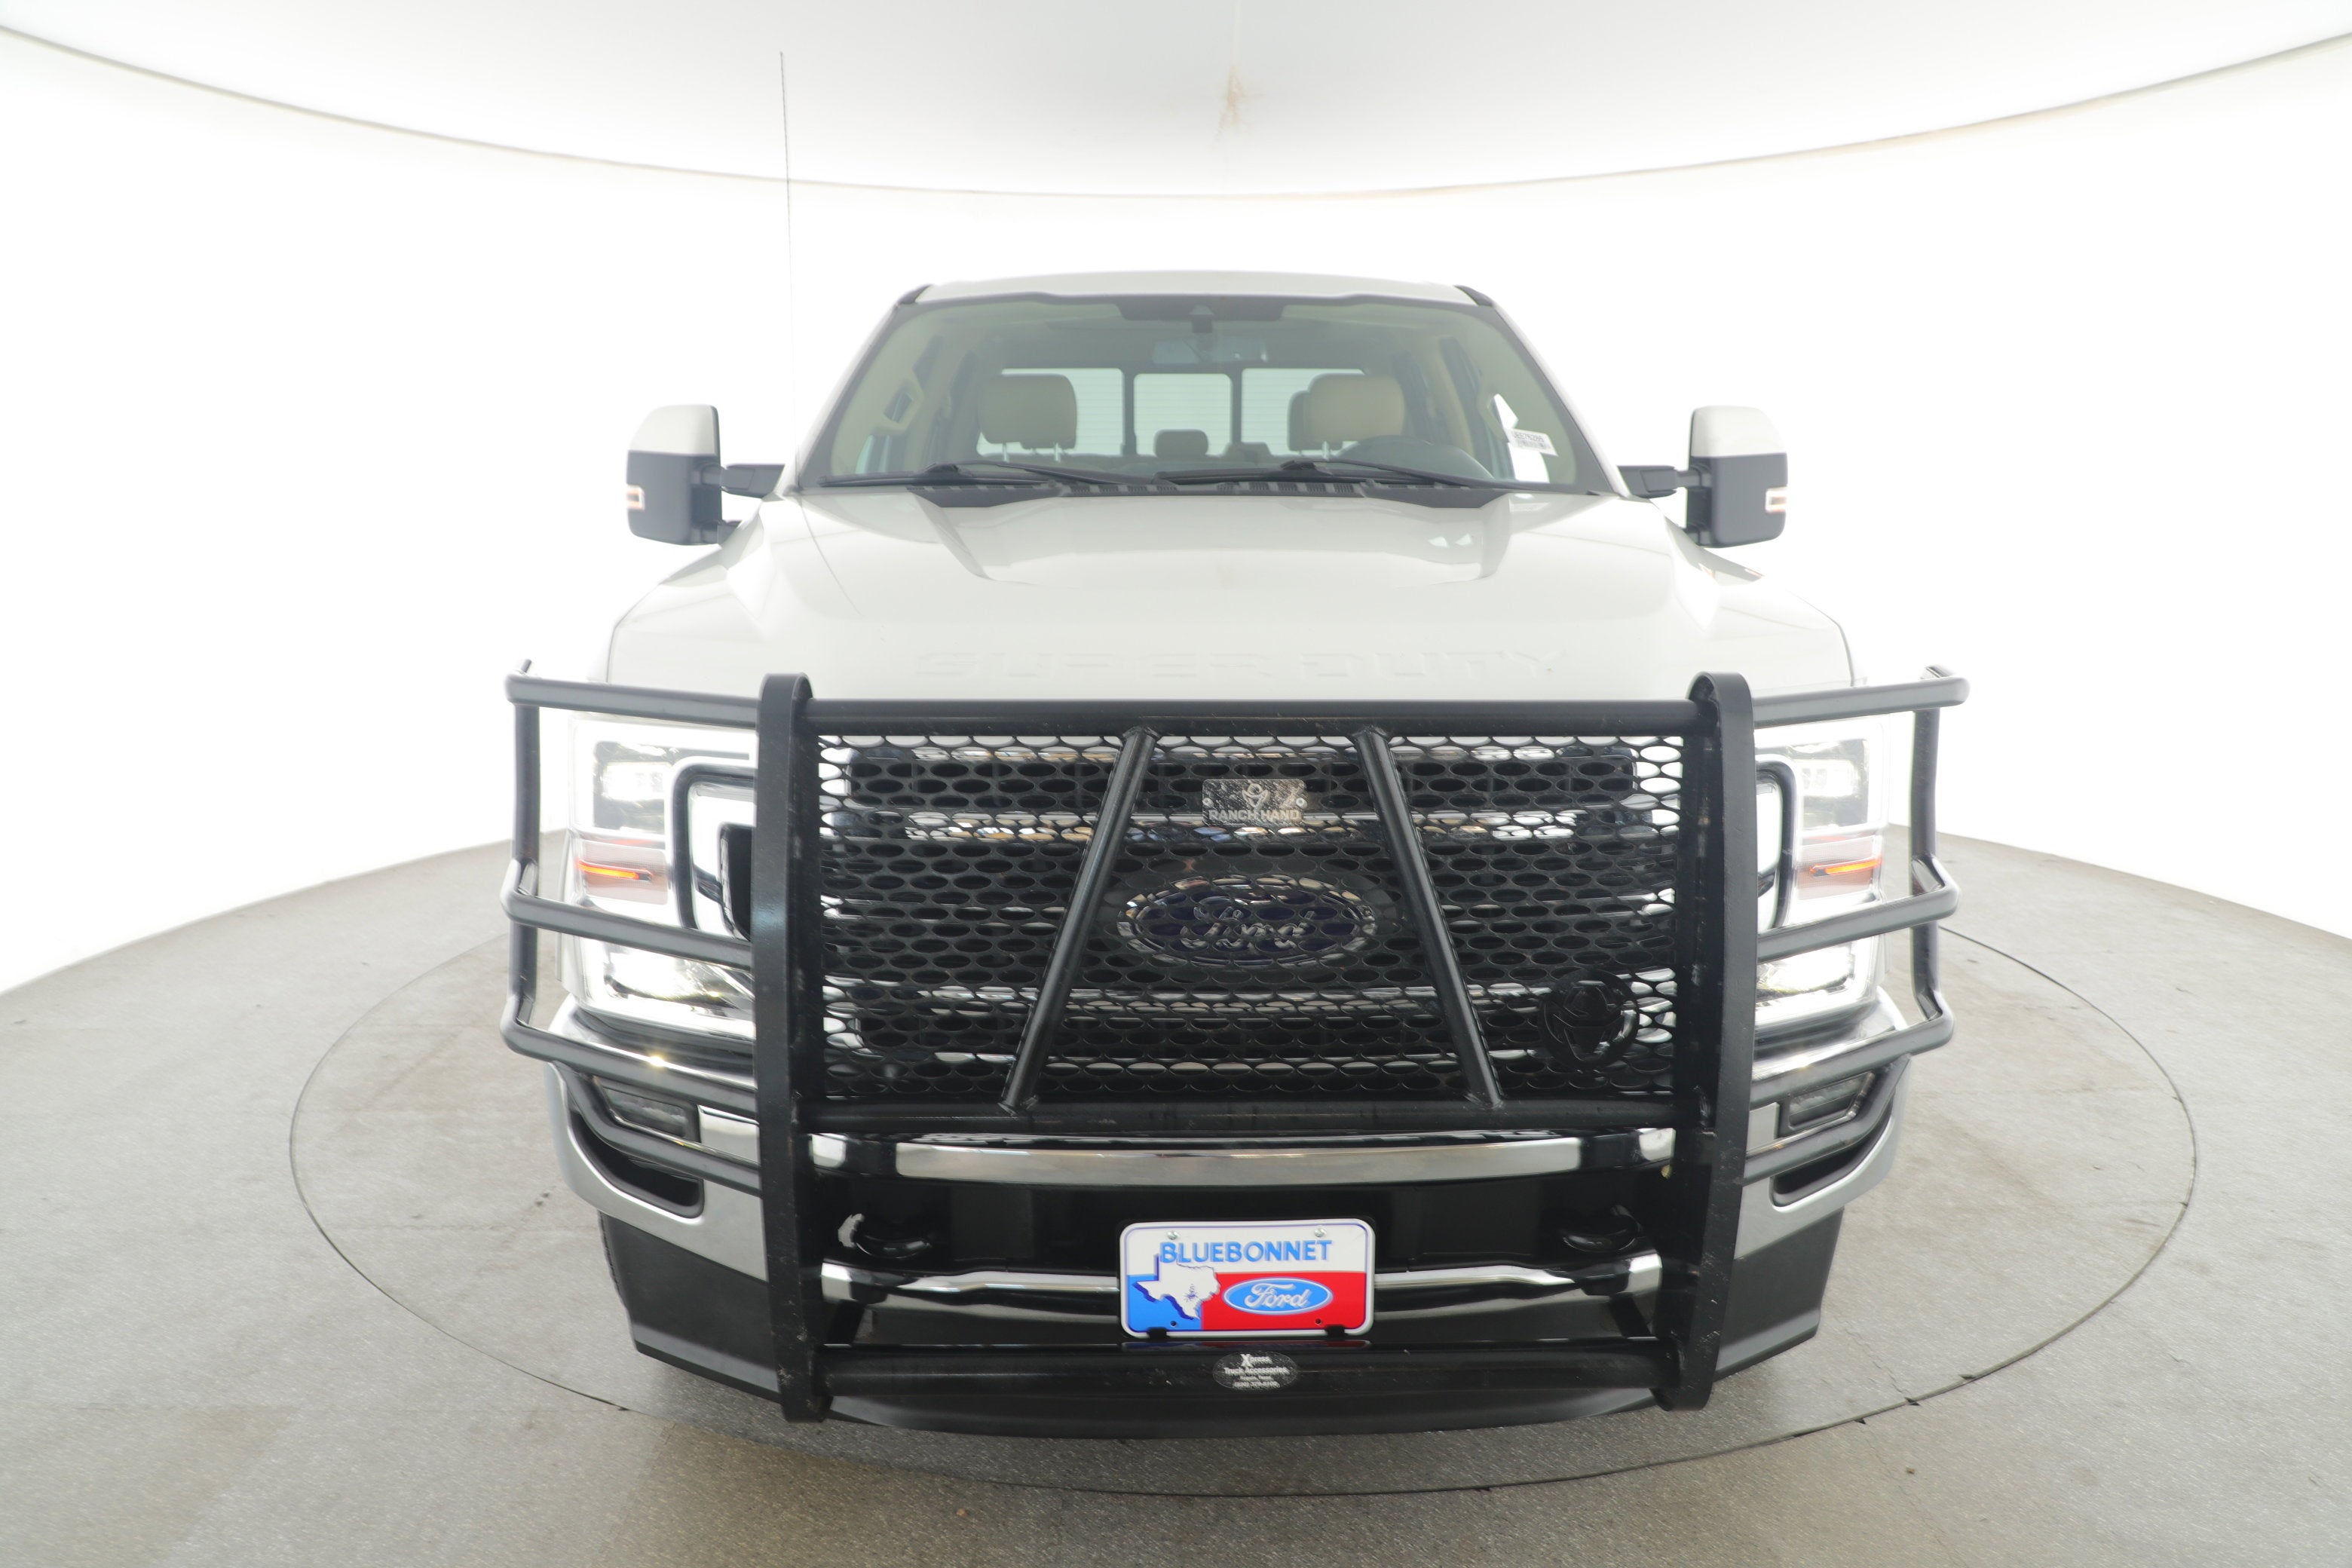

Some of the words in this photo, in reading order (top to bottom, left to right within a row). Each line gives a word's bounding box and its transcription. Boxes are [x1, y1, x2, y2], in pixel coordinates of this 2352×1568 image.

[915, 651, 1272, 679] SUPER
[1300, 651, 1566, 679] DUTY
[1208, 810, 1256, 821] RANCH
[1261, 809, 1301, 820] HAND
[1159, 1240, 1332, 1263] BLUEBONNET
[1244, 1283, 1310, 1308] Ford
[1240, 1353, 1272, 1367] Xpress
[1245, 1366, 1288, 1375] Accessories
